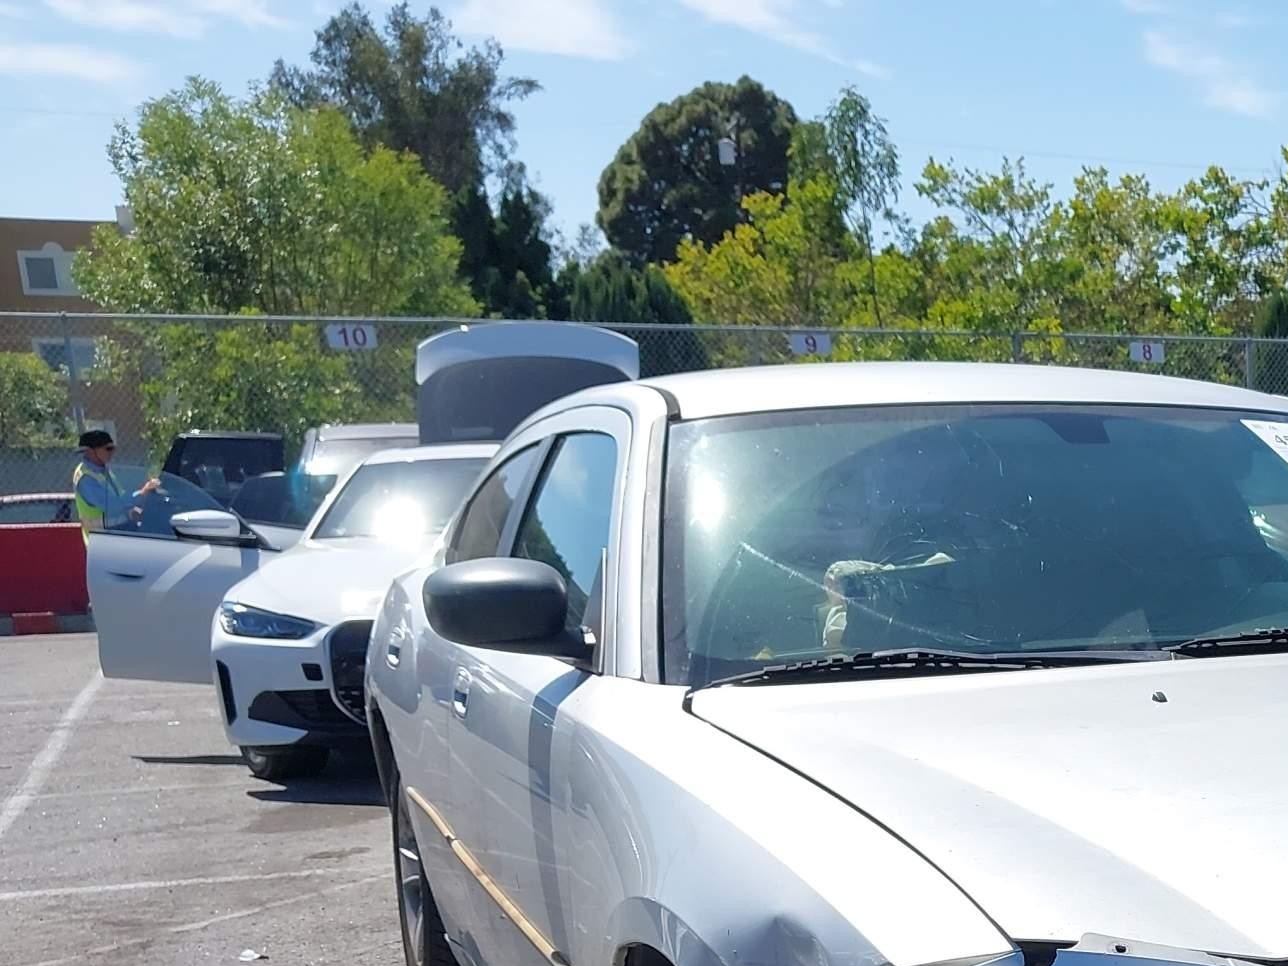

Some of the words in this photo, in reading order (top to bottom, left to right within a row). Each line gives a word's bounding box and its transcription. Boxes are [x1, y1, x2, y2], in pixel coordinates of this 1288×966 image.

[337, 327, 367, 347] 10
[804, 335, 817, 353] 9
[1142, 344, 1152, 361] 8
